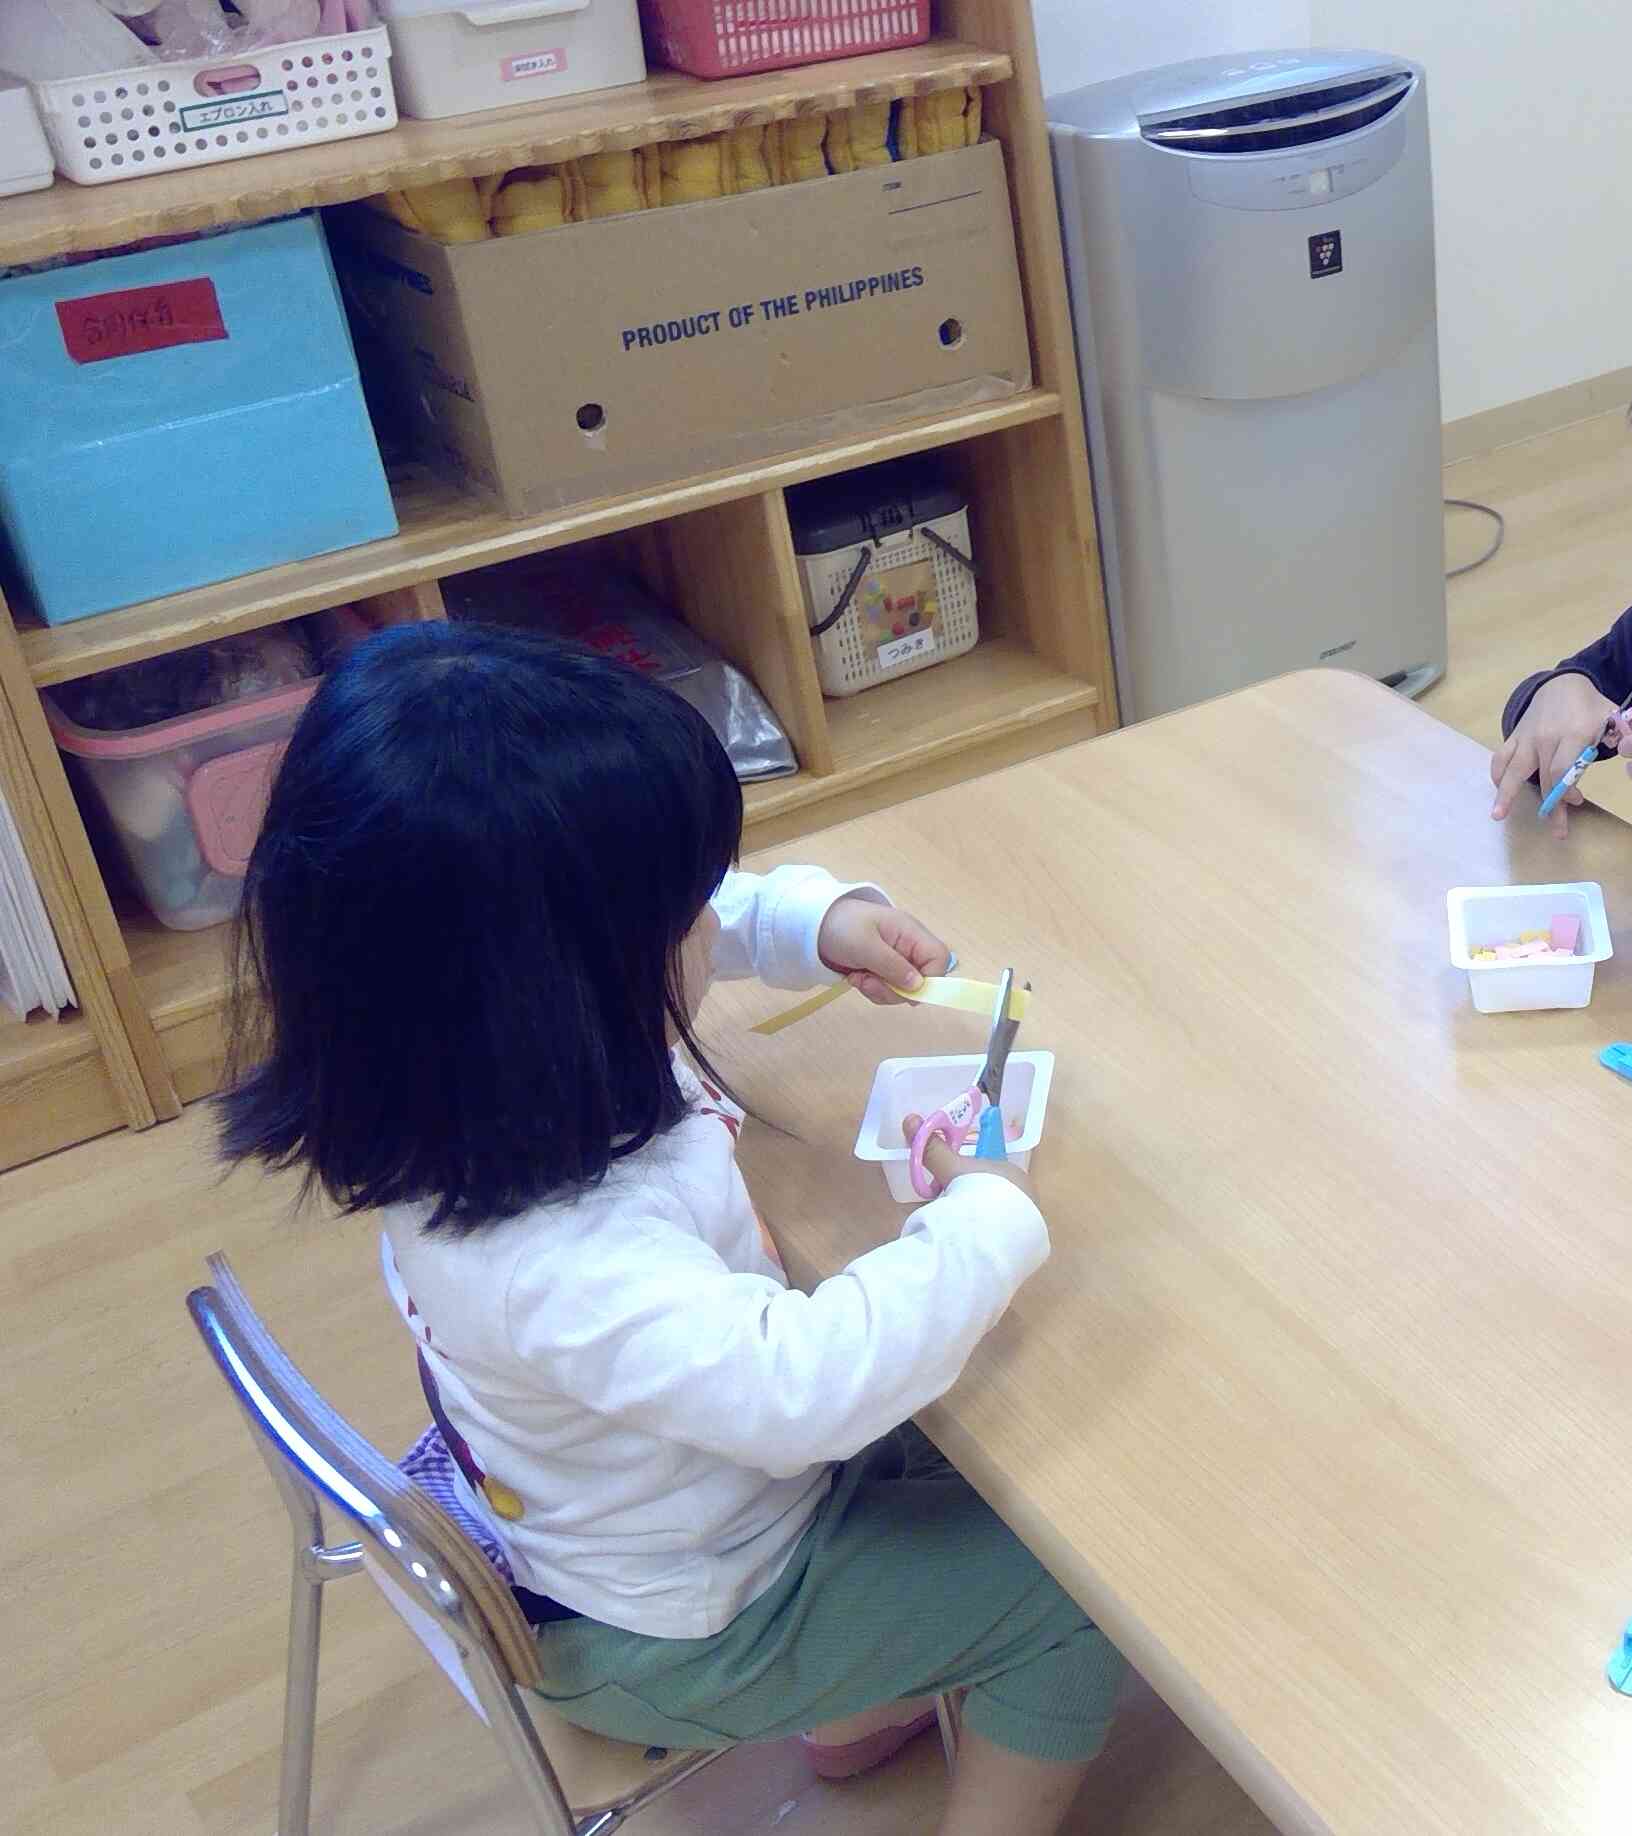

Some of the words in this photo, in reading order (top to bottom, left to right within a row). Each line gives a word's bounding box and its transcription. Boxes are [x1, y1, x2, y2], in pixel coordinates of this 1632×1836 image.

[200, 101, 273, 121] エプロン入れ
[622, 311, 721, 351] PRODUCT
[729, 304, 754, 328] OF
[760, 295, 800, 320] THE
[804, 266, 924, 311] PHILIPPINES
